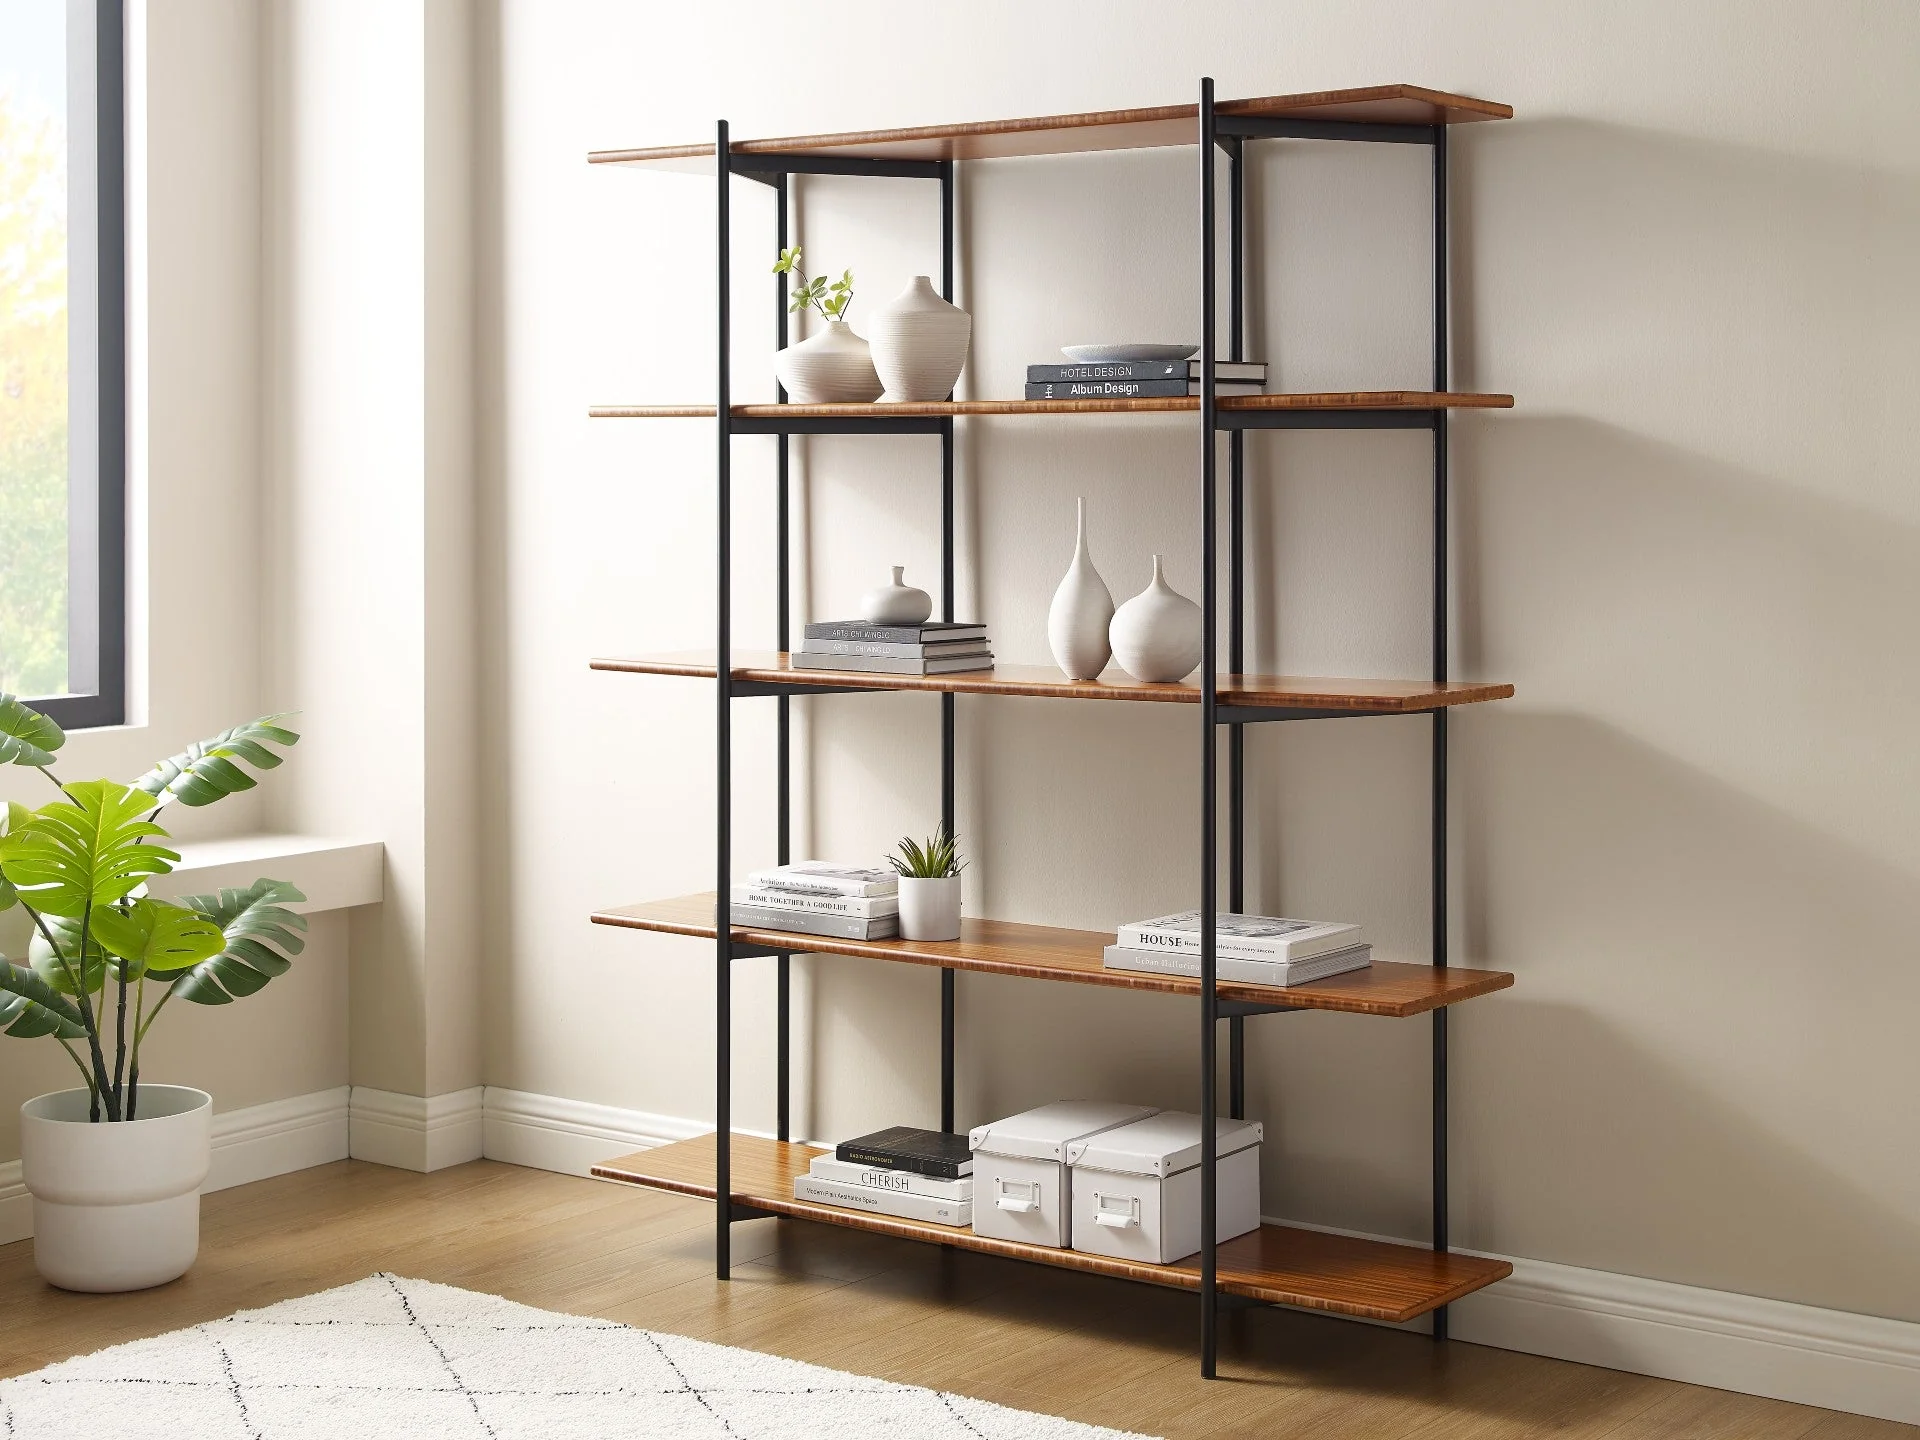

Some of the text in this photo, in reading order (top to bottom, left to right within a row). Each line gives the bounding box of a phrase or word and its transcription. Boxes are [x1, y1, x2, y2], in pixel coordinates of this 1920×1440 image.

[1060, 367, 1132, 378] HOTEL DESIGN
[1070, 383, 1139, 395] Album Design
[749, 894, 768, 903] HOME
[769, 896, 804, 907] TOGETHER
[813, 901, 833, 909] GOOD
[833, 903, 848, 911] LIFE
[1139, 933, 1182, 948] HOUSE
[1135, 956, 1159, 967] Urban
[861, 1172, 909, 1191] CHERISH
